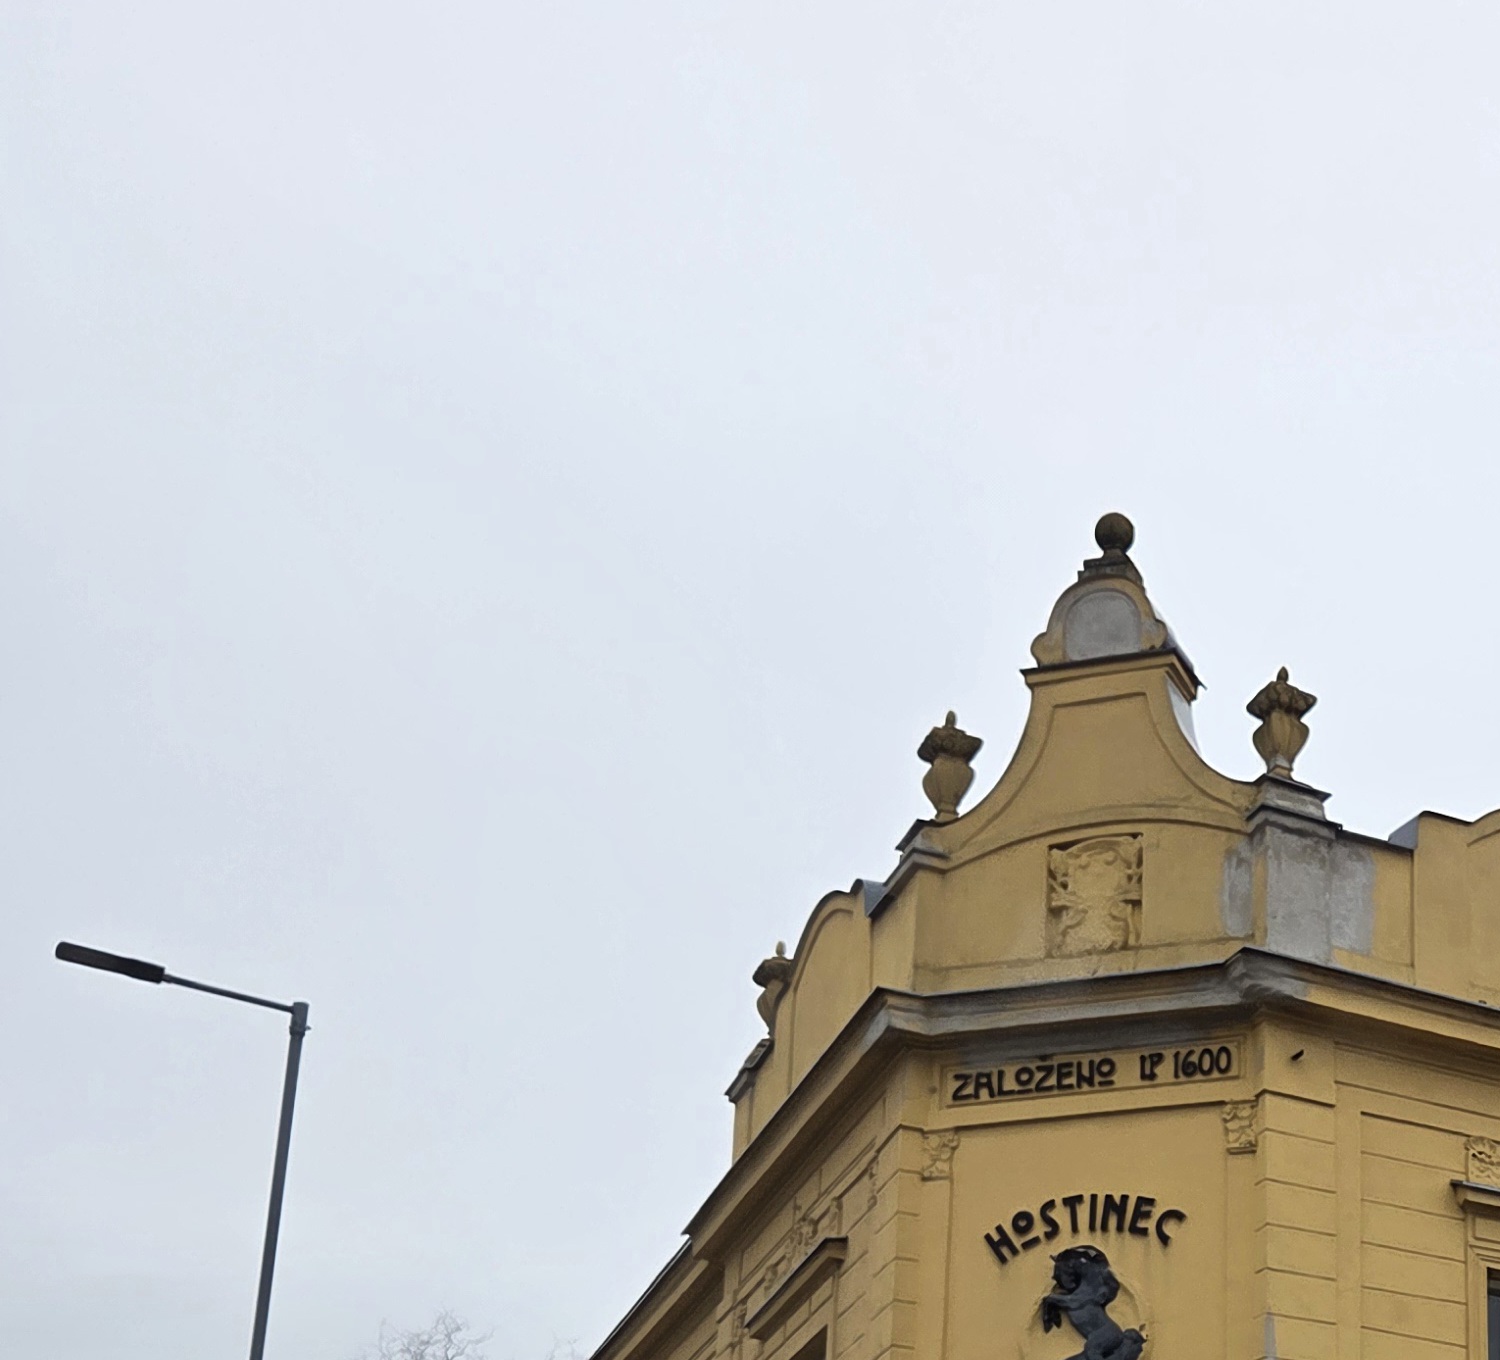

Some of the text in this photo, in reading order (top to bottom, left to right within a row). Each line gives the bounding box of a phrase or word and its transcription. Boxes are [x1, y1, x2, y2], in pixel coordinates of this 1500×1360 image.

[952, 1055, 1115, 1101] ZALOŽENO
[1173, 1046, 1232, 1079] 1600
[984, 1194, 1187, 1265] HOSTINEC
